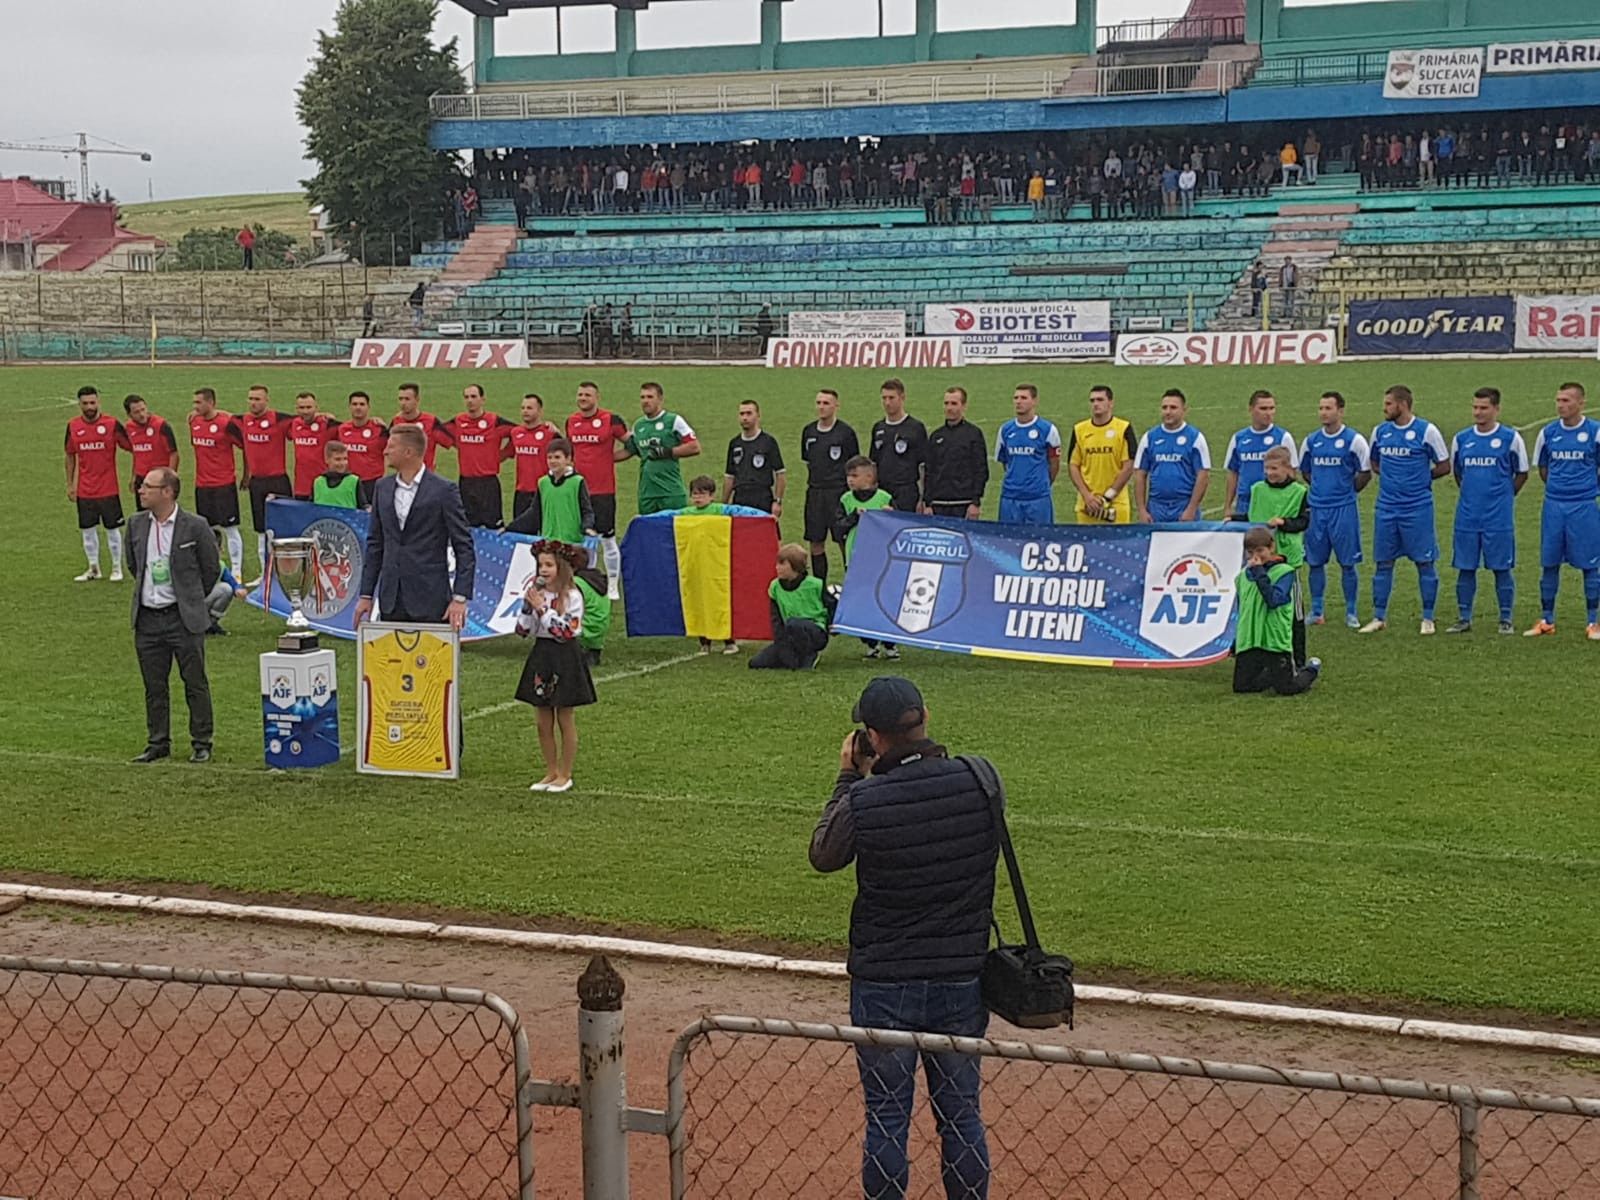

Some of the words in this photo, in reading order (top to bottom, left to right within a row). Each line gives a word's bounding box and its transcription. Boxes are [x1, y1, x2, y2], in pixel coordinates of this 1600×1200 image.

[1494, 42, 1600, 65] PRIMĂRI
[1419, 68, 1476, 80] SUCEAVA
[1418, 83, 1446, 95] ESTE
[1449, 82, 1475, 94] AICI
[980, 306, 1026, 314] CENTRUL
[1031, 305, 1077, 313] MEDICAL
[980, 314, 1077, 330] BIOTEST
[1041, 333, 1083, 341] MEDICALE
[357, 343, 514, 368] RAILEX
[772, 340, 953, 368] CONBUCOVINA
[1184, 333, 1328, 366] SUMEC
[1380, 447, 1412, 457] RAILEX
[1551, 450, 1585, 460] RAILEX
[1464, 457, 1497, 466] RAILEX
[895, 540, 969, 558] VIITORUL
[1021, 542, 1088, 573] C.S.O.
[993, 574, 1106, 609] VIITORUL
[1149, 594, 1221, 625] AJF
[1005, 608, 1085, 642] LITENI
[313, 685, 327, 697] AJF
[401, 674, 414, 692] 3
[273, 689, 292, 698] AJF
